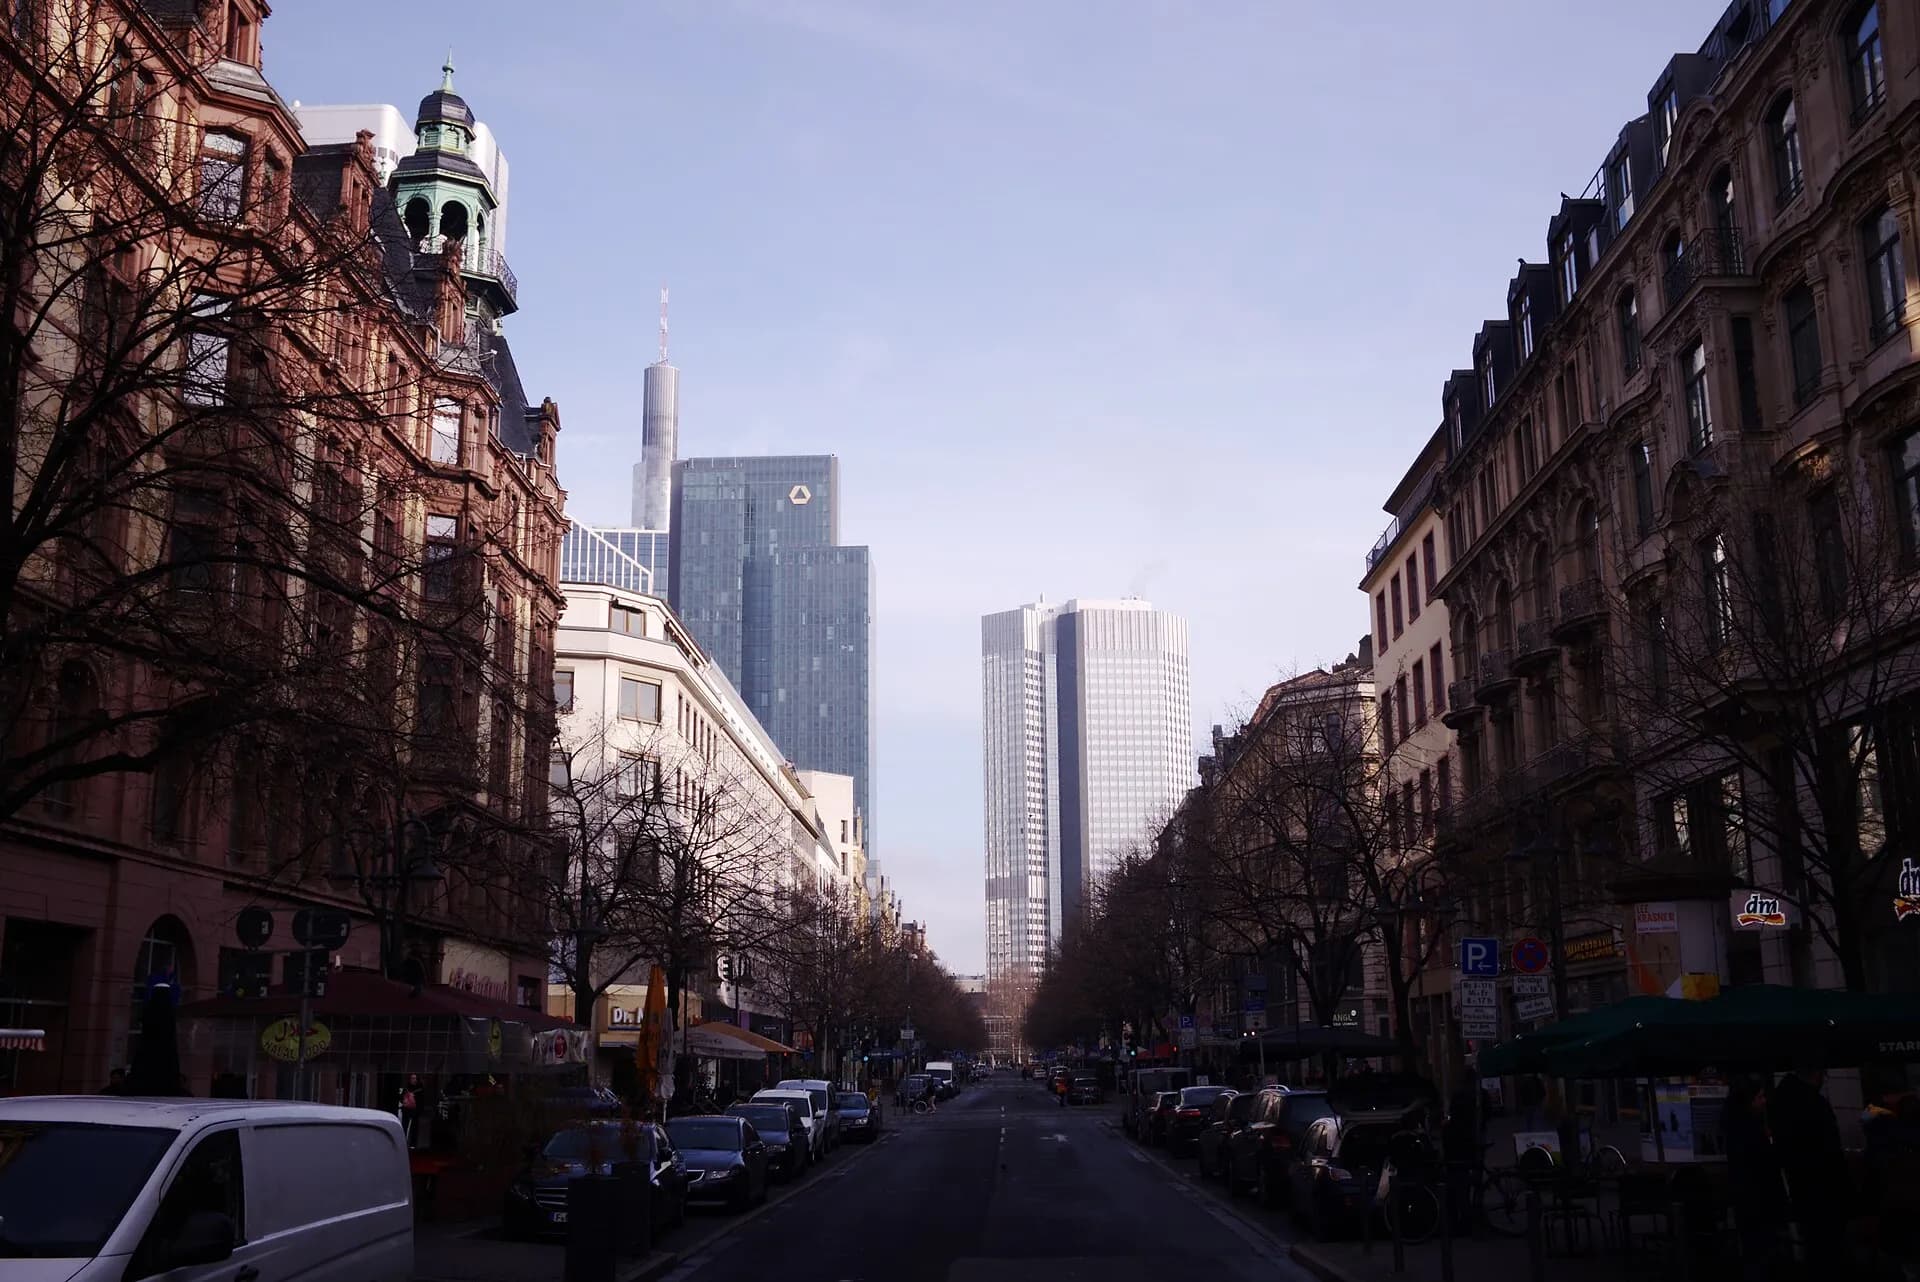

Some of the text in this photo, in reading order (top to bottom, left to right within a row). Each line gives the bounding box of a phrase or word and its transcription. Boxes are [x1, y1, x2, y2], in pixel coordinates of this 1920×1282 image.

[1638, 904, 1649, 913] LEE
[1745, 894, 1778, 914] dm
[1638, 912, 1675, 921] KRASNER
[1467, 943, 1488, 970] P
